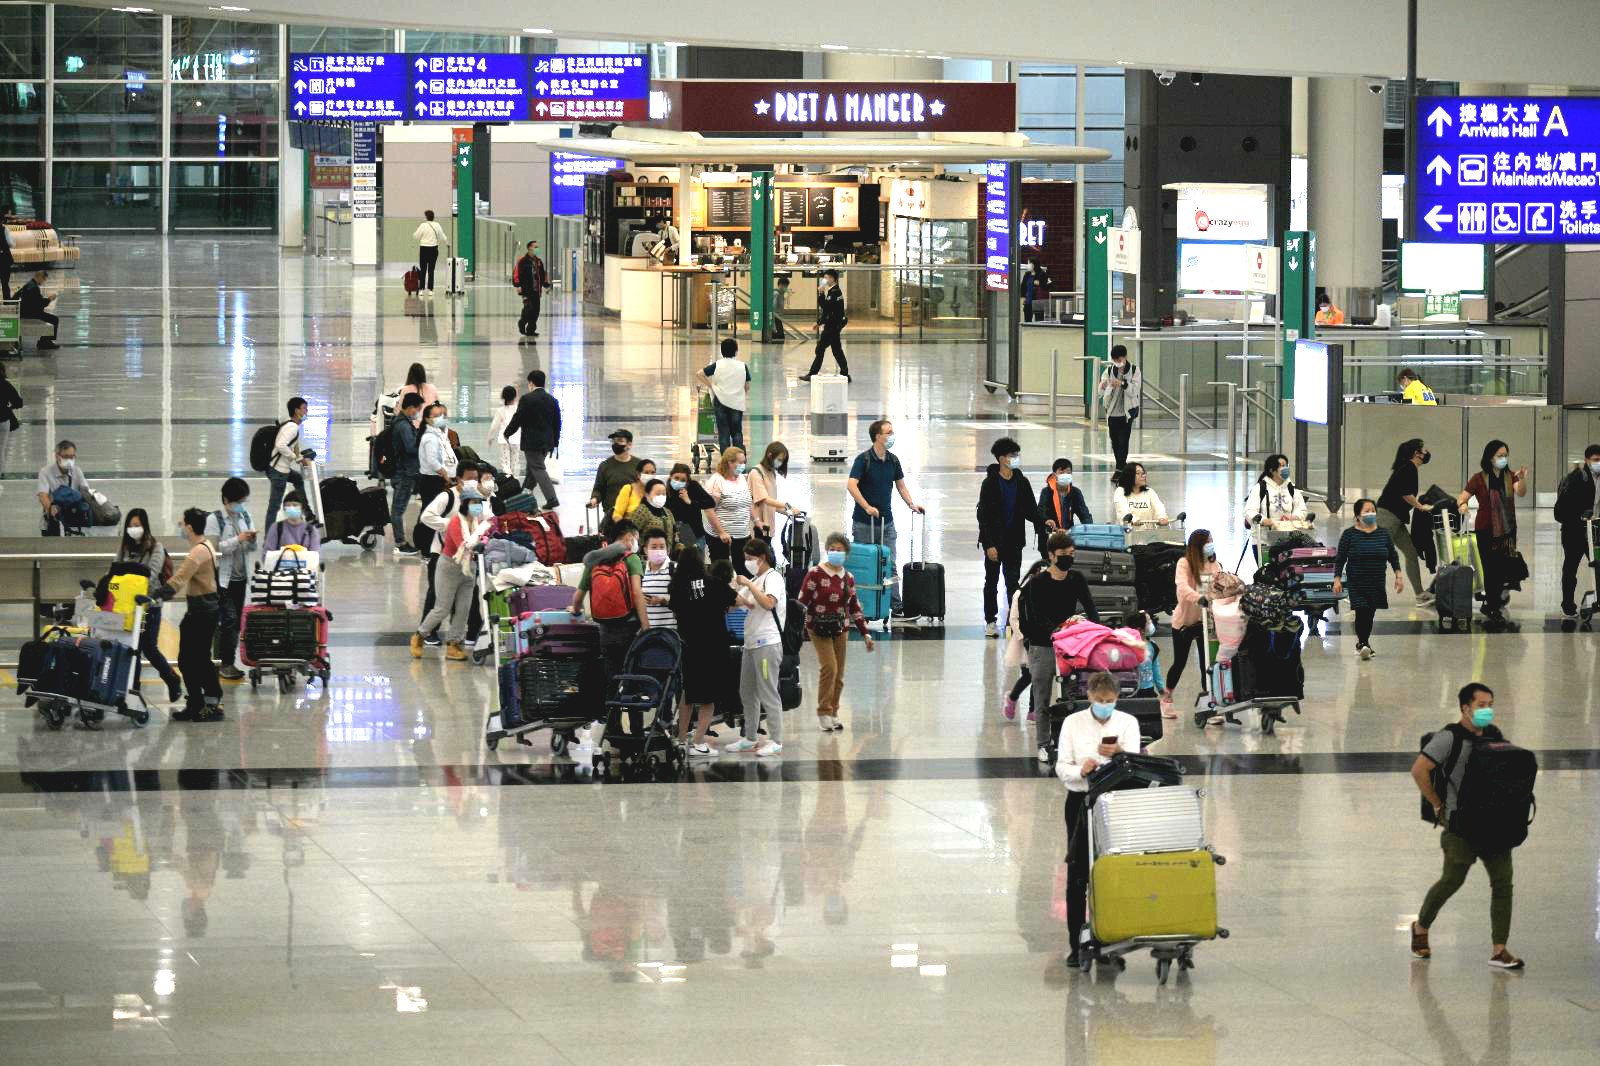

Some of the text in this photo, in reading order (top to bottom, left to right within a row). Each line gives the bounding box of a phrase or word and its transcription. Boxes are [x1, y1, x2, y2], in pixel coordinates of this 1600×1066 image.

[477, 57, 487, 72] 4
[775, 92, 925, 122] PRET A MANGER
[1459, 103, 1569, 137] 接機大堂 A
[1459, 123, 1537, 138] Arrivals Hall
[1493, 173, 1596, 187] Mainland/Macao
[1019, 220, 1046, 246] RET
[1559, 220, 1600, 235] Toilets
